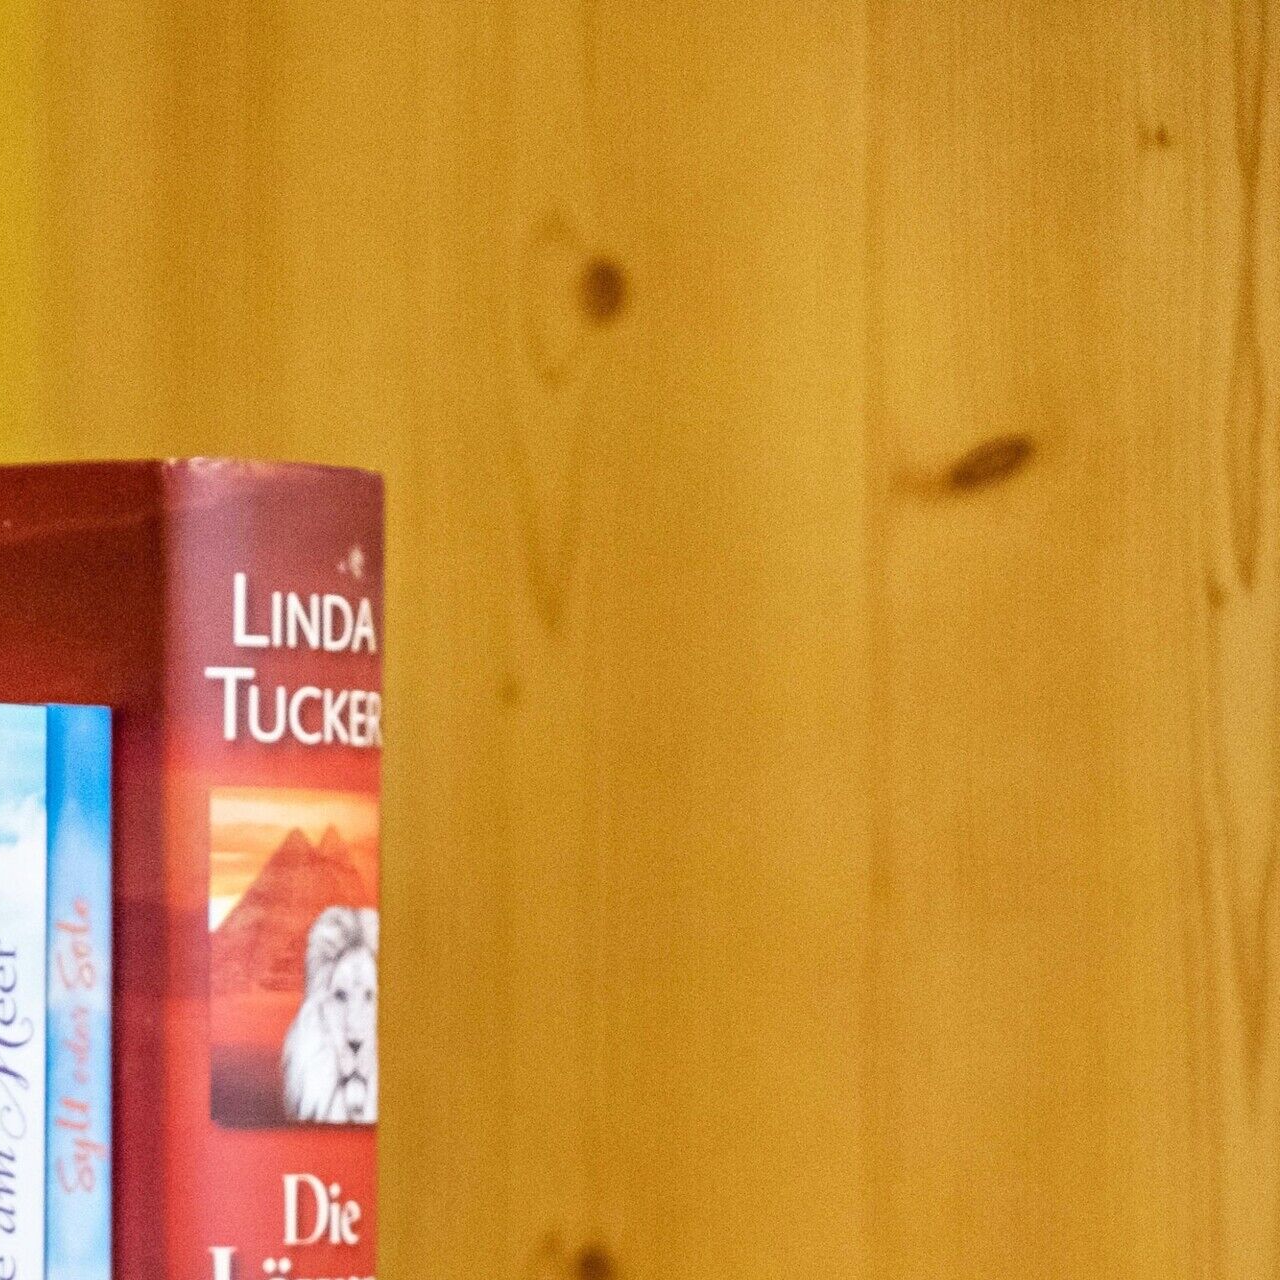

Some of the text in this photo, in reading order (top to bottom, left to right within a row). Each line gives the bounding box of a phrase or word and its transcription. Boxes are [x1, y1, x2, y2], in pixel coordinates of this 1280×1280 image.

[233, 572, 377, 653] LINDA
[204, 666, 382, 747] TUCKER
[283, 1173, 362, 1245] Die
